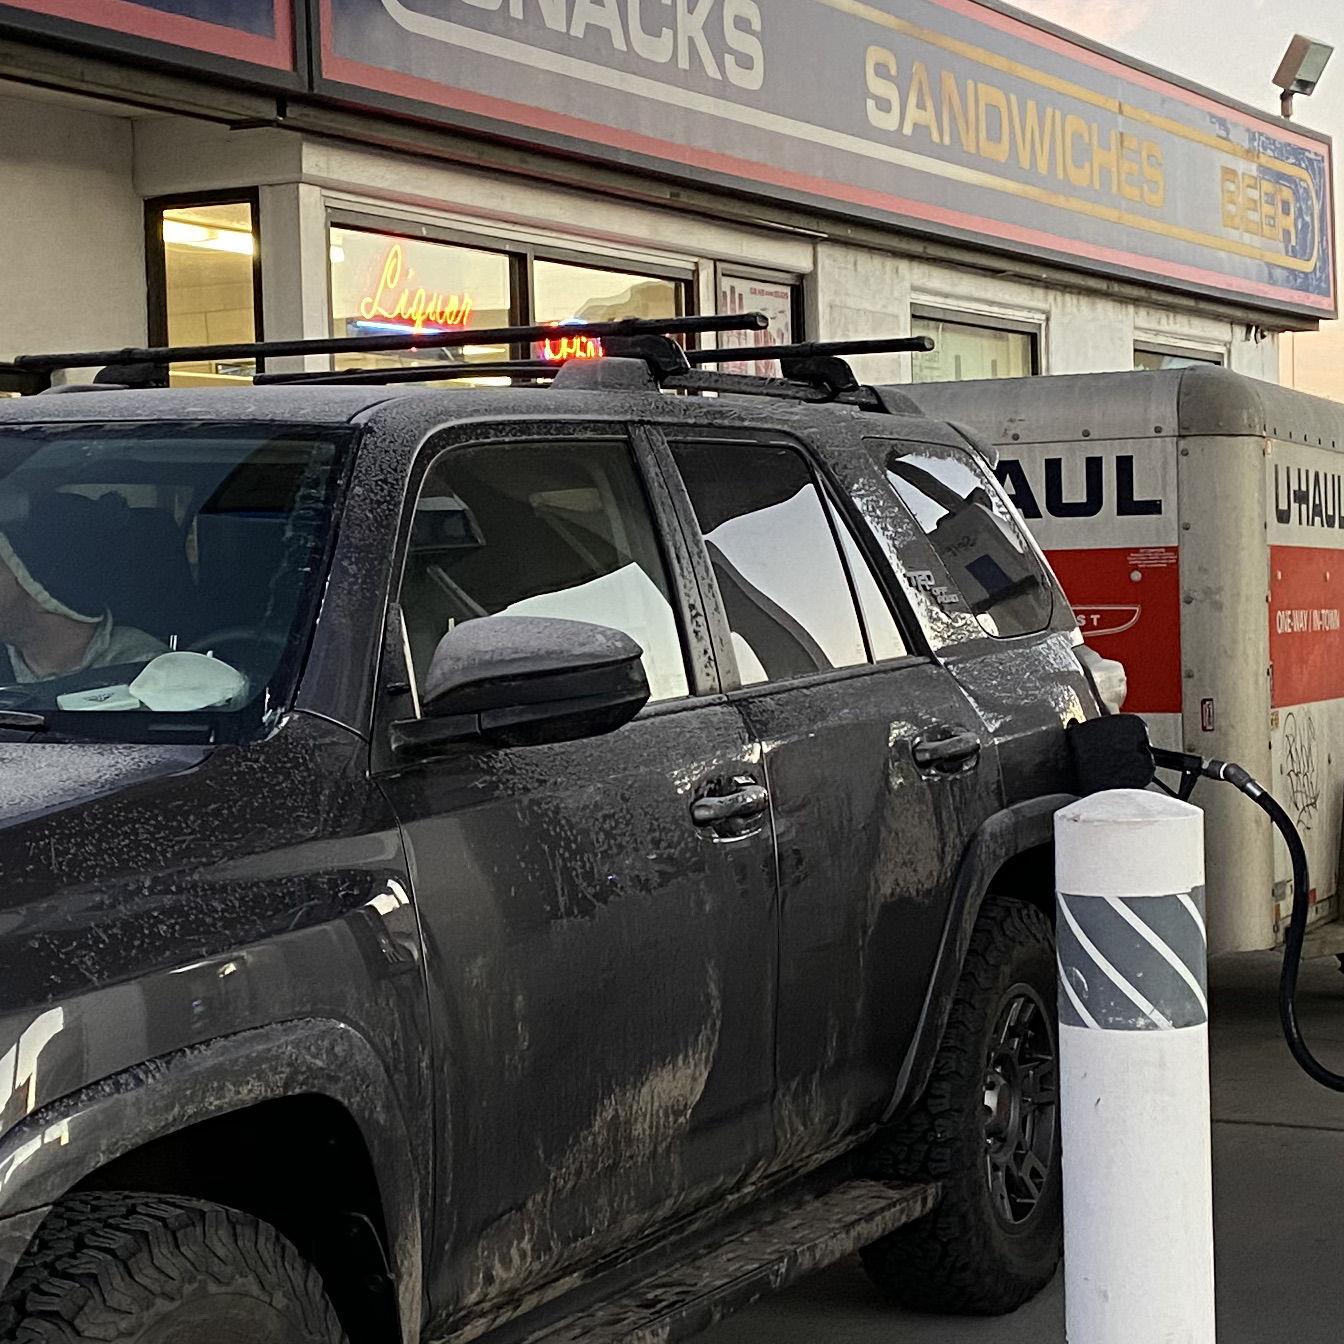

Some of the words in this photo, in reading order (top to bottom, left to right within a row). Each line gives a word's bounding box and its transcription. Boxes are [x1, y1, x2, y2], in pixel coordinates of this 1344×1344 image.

[864, 45, 1166, 208] SANDWICHES
[1220, 165, 1298, 248] BEER
[360, 244, 473, 329] Liquor
